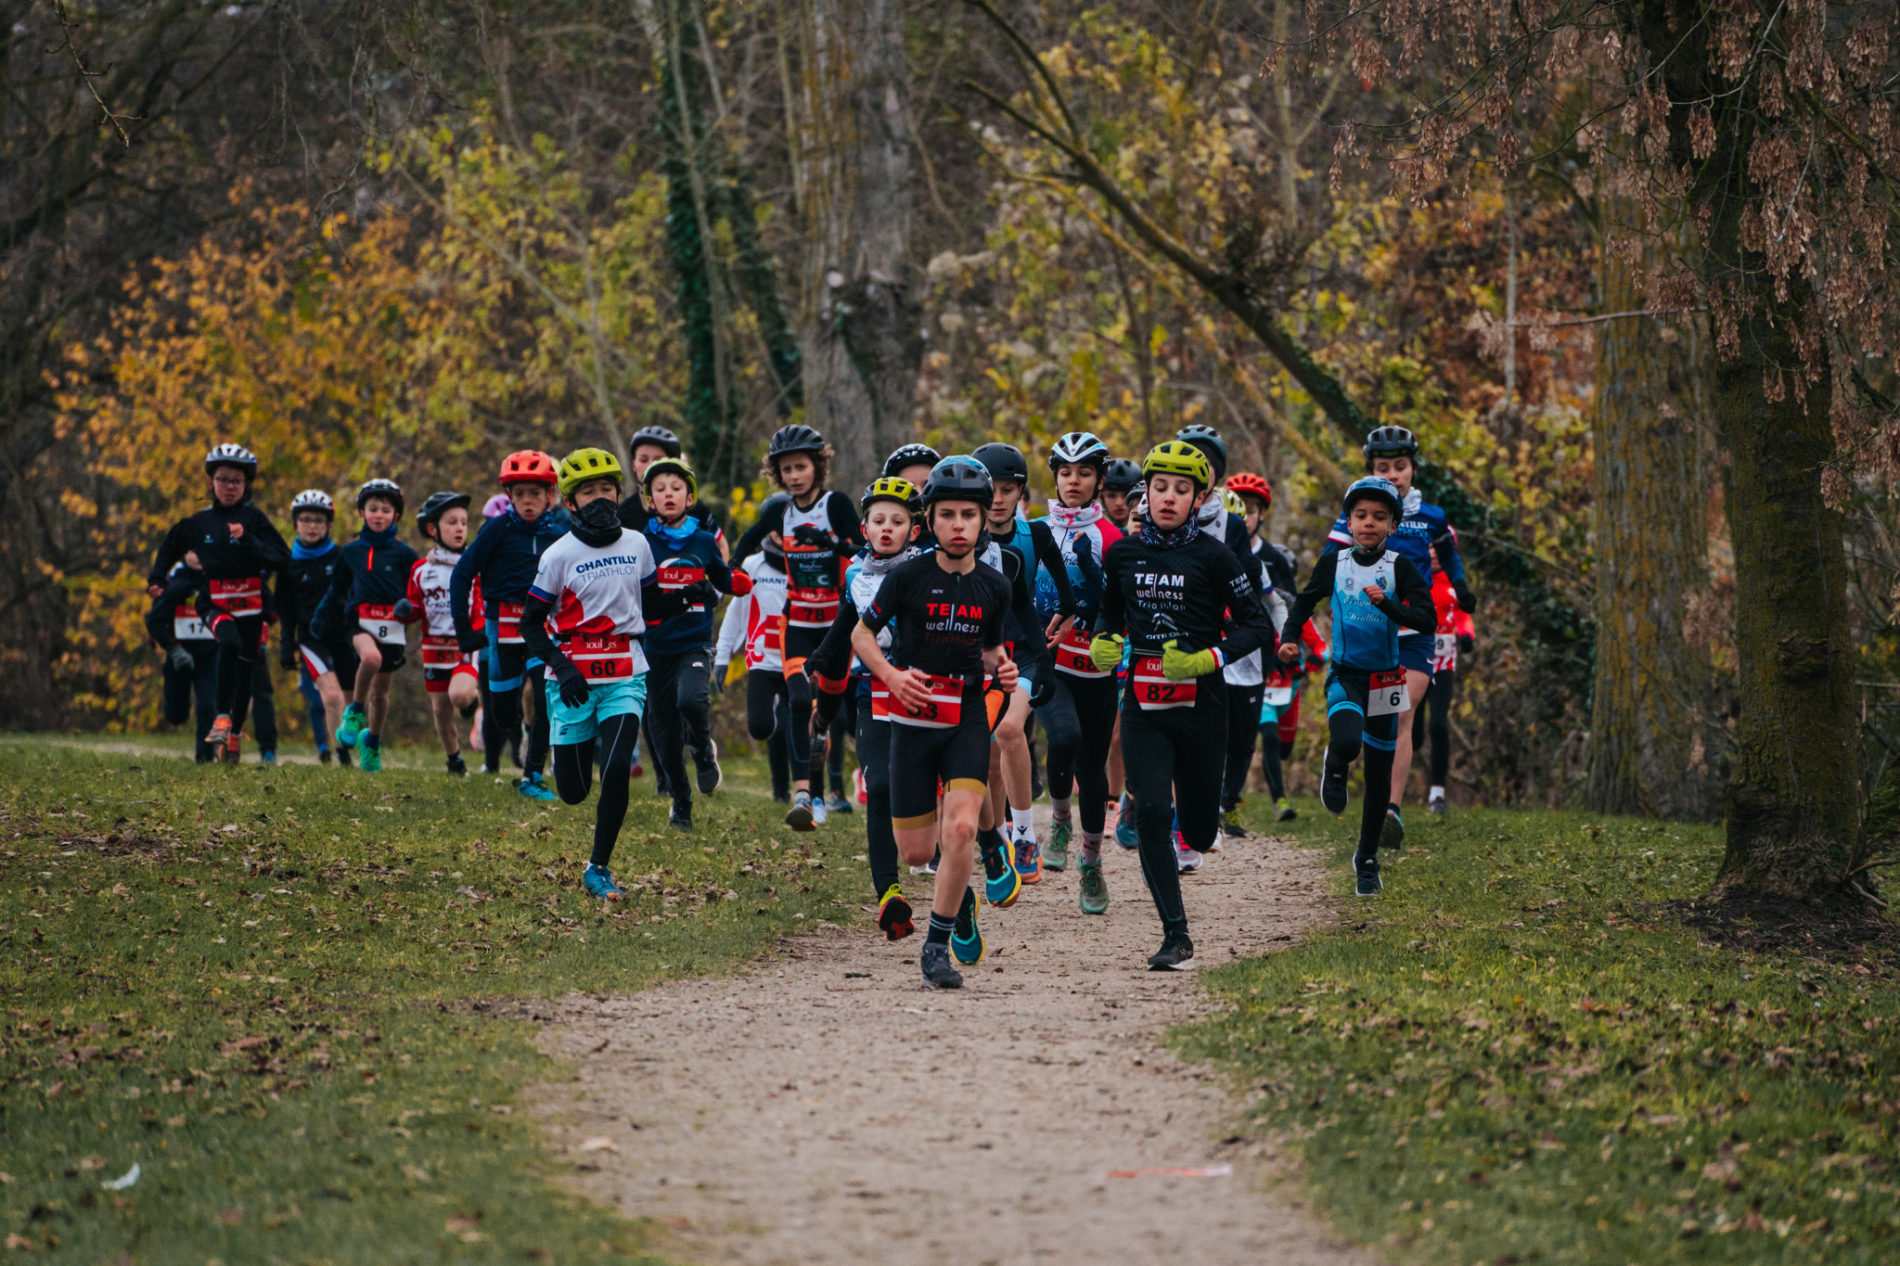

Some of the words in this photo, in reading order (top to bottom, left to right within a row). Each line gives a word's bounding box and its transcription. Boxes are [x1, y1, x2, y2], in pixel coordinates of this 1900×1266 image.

[576, 555, 637, 574] CHANTILLY
[1134, 573, 1184, 587] TEAM
[1136, 582, 1184, 600] wellness
[804, 606, 825, 622] 78
[926, 603, 983, 619] TEAM
[188, 622, 205, 634] 17
[926, 612, 980, 633] wellness
[378, 626, 388, 638] 8
[590, 660, 617, 677] 60
[1147, 684, 1175, 702] 82
[1389, 691, 1401, 707] 6
